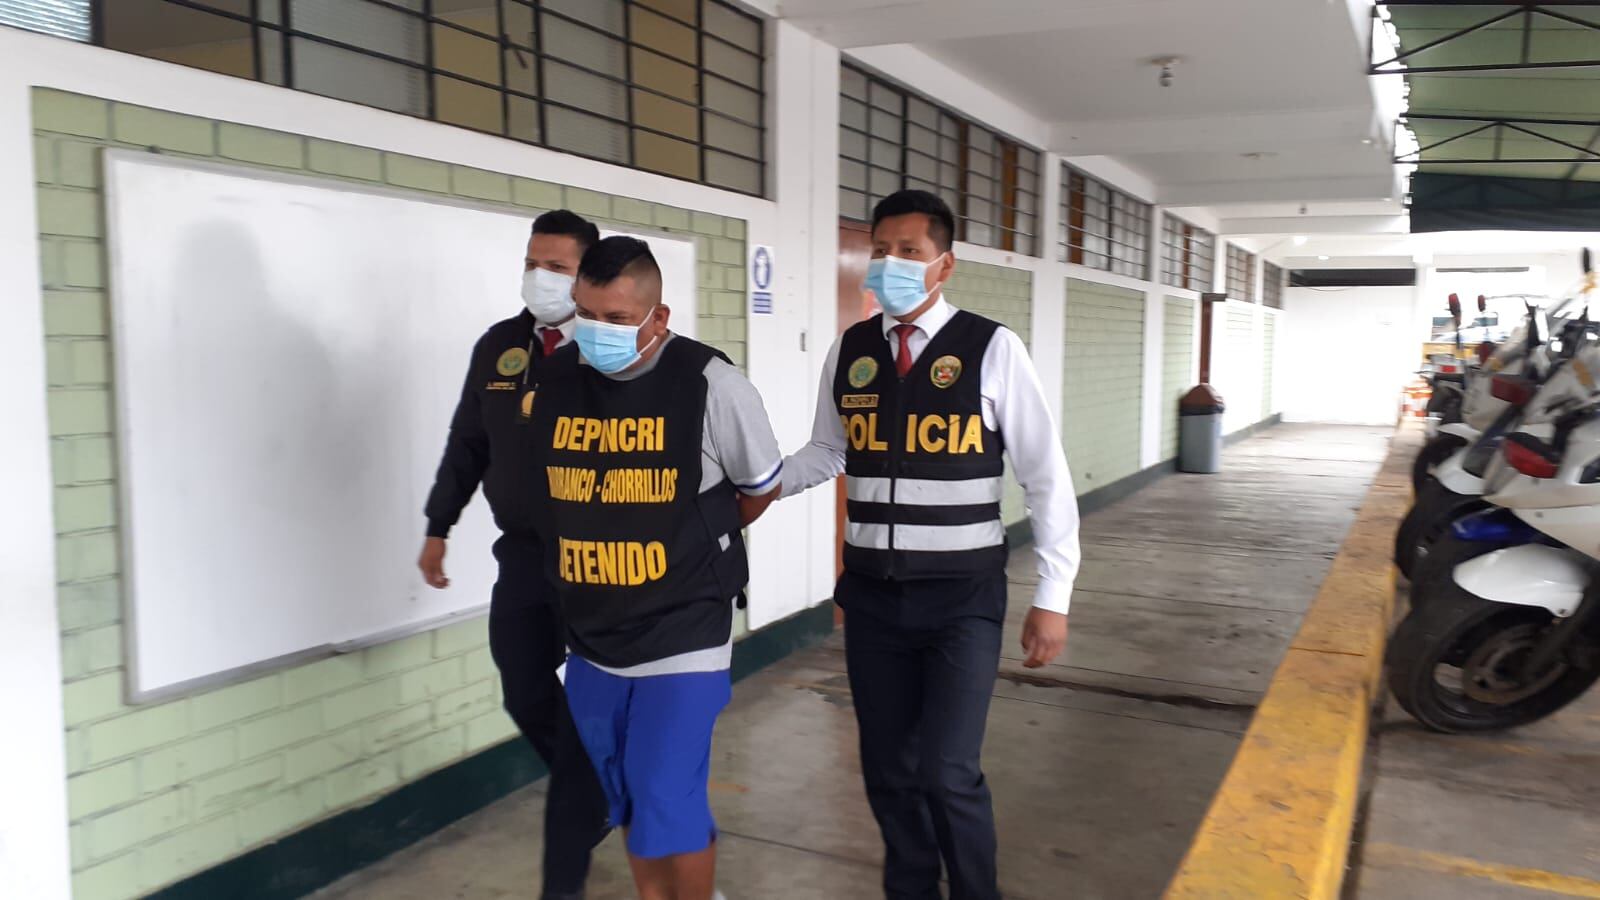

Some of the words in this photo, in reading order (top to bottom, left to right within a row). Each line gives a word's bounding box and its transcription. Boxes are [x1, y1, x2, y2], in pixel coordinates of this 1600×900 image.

[553, 416, 665, 453] DEPNCRI
[601, 467, 678, 504] CHORRILLOS
[559, 536, 667, 586] ETENIDO
